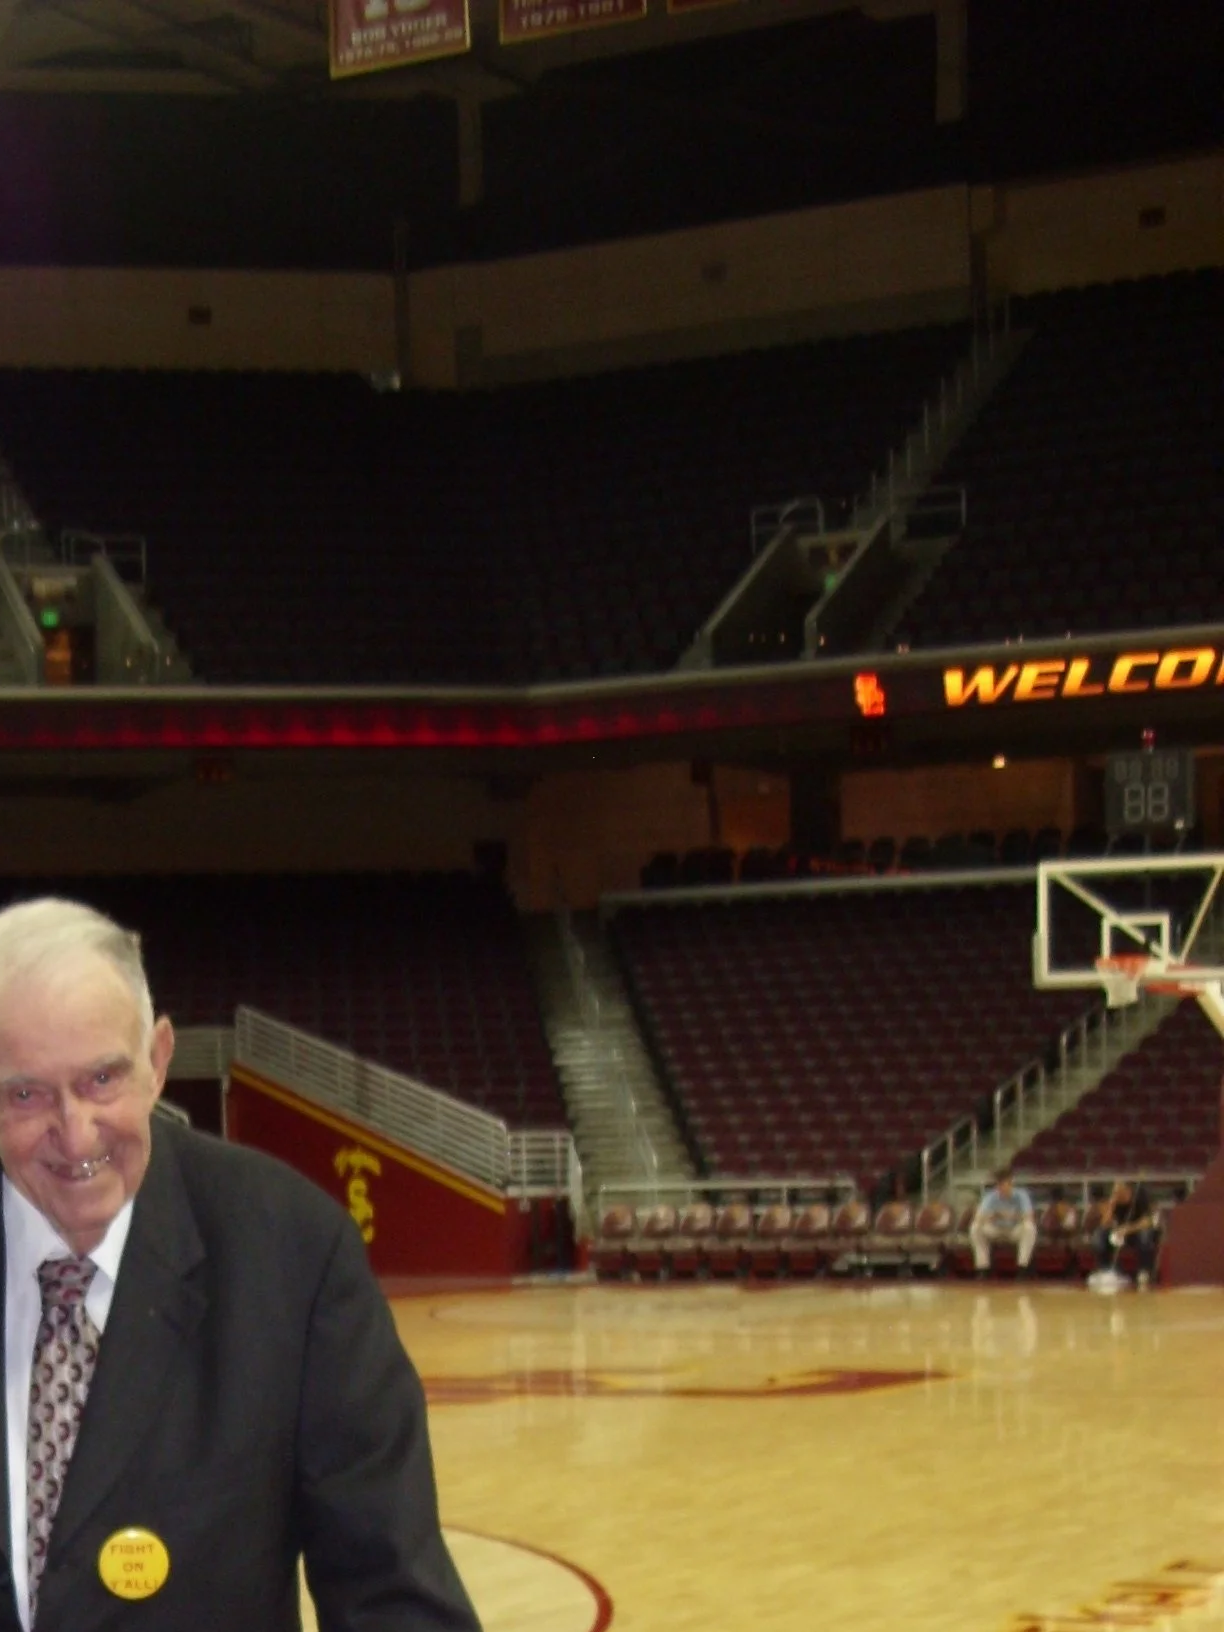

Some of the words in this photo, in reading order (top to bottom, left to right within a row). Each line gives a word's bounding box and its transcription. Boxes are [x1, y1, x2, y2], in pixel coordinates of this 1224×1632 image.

[943, 647, 1224, 708] WELCO
[110, 1543, 155, 1556] FIGHT
[122, 1562, 144, 1573] ON
